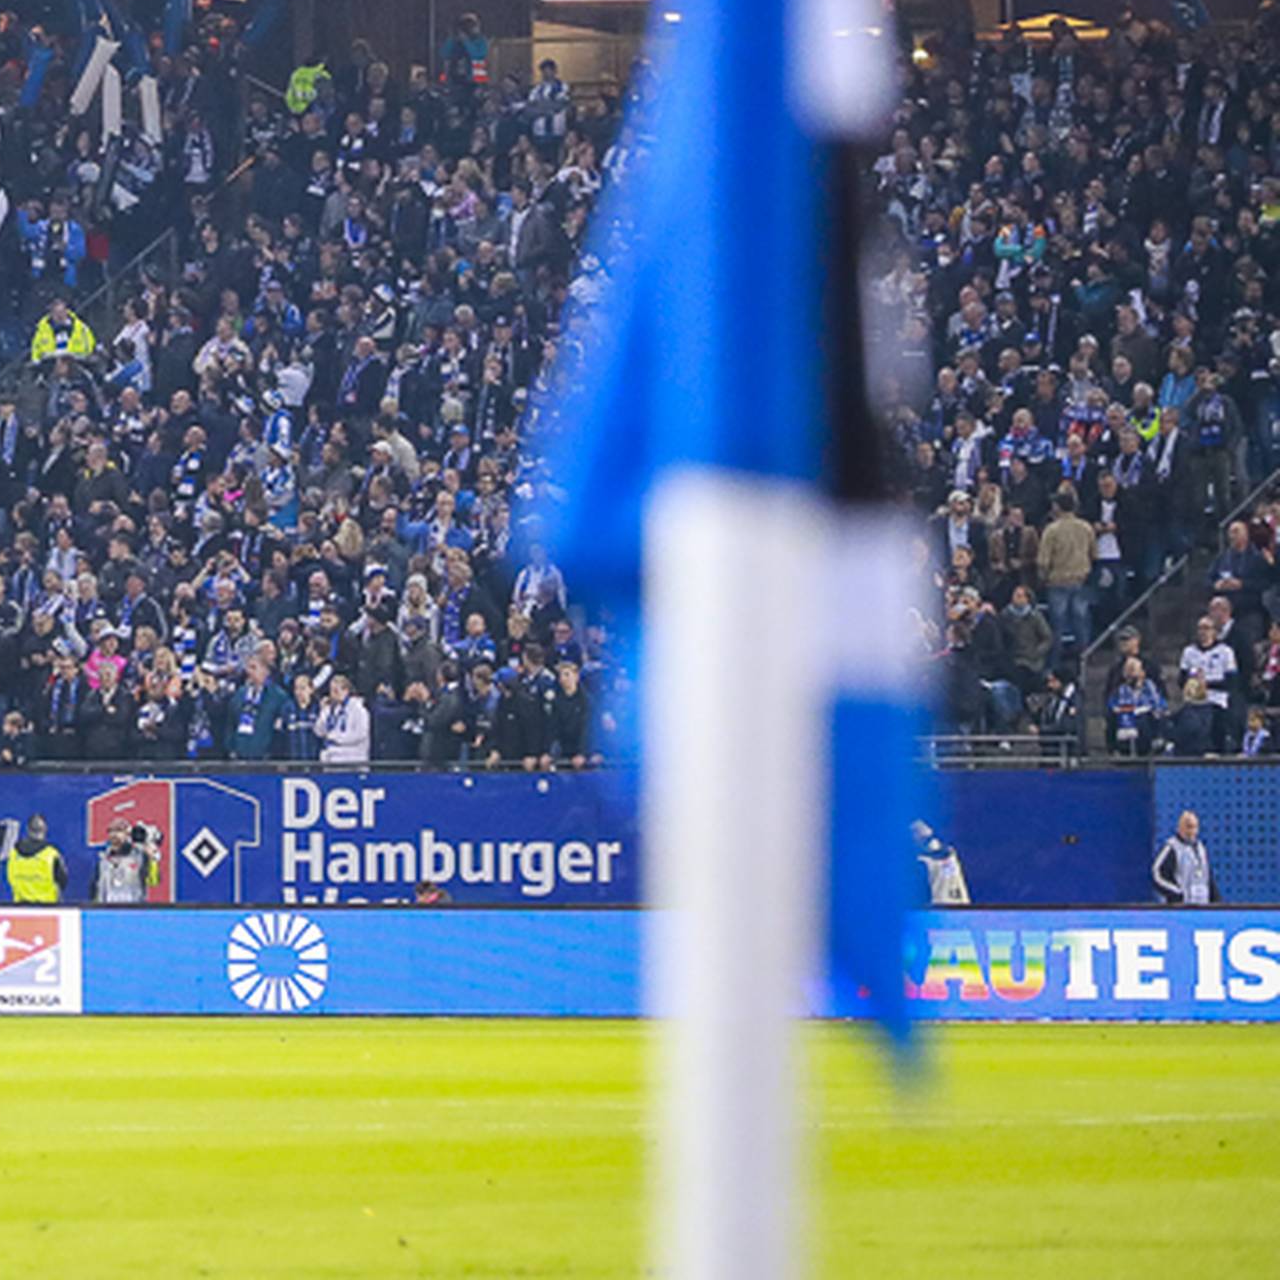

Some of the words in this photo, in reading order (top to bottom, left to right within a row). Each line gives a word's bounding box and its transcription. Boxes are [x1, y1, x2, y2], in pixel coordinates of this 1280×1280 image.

[283, 777, 385, 829] Der
[283, 829, 622, 898] Hamburger
[35, 949, 57, 983] 2
[905, 929, 1170, 1002] AUTE
